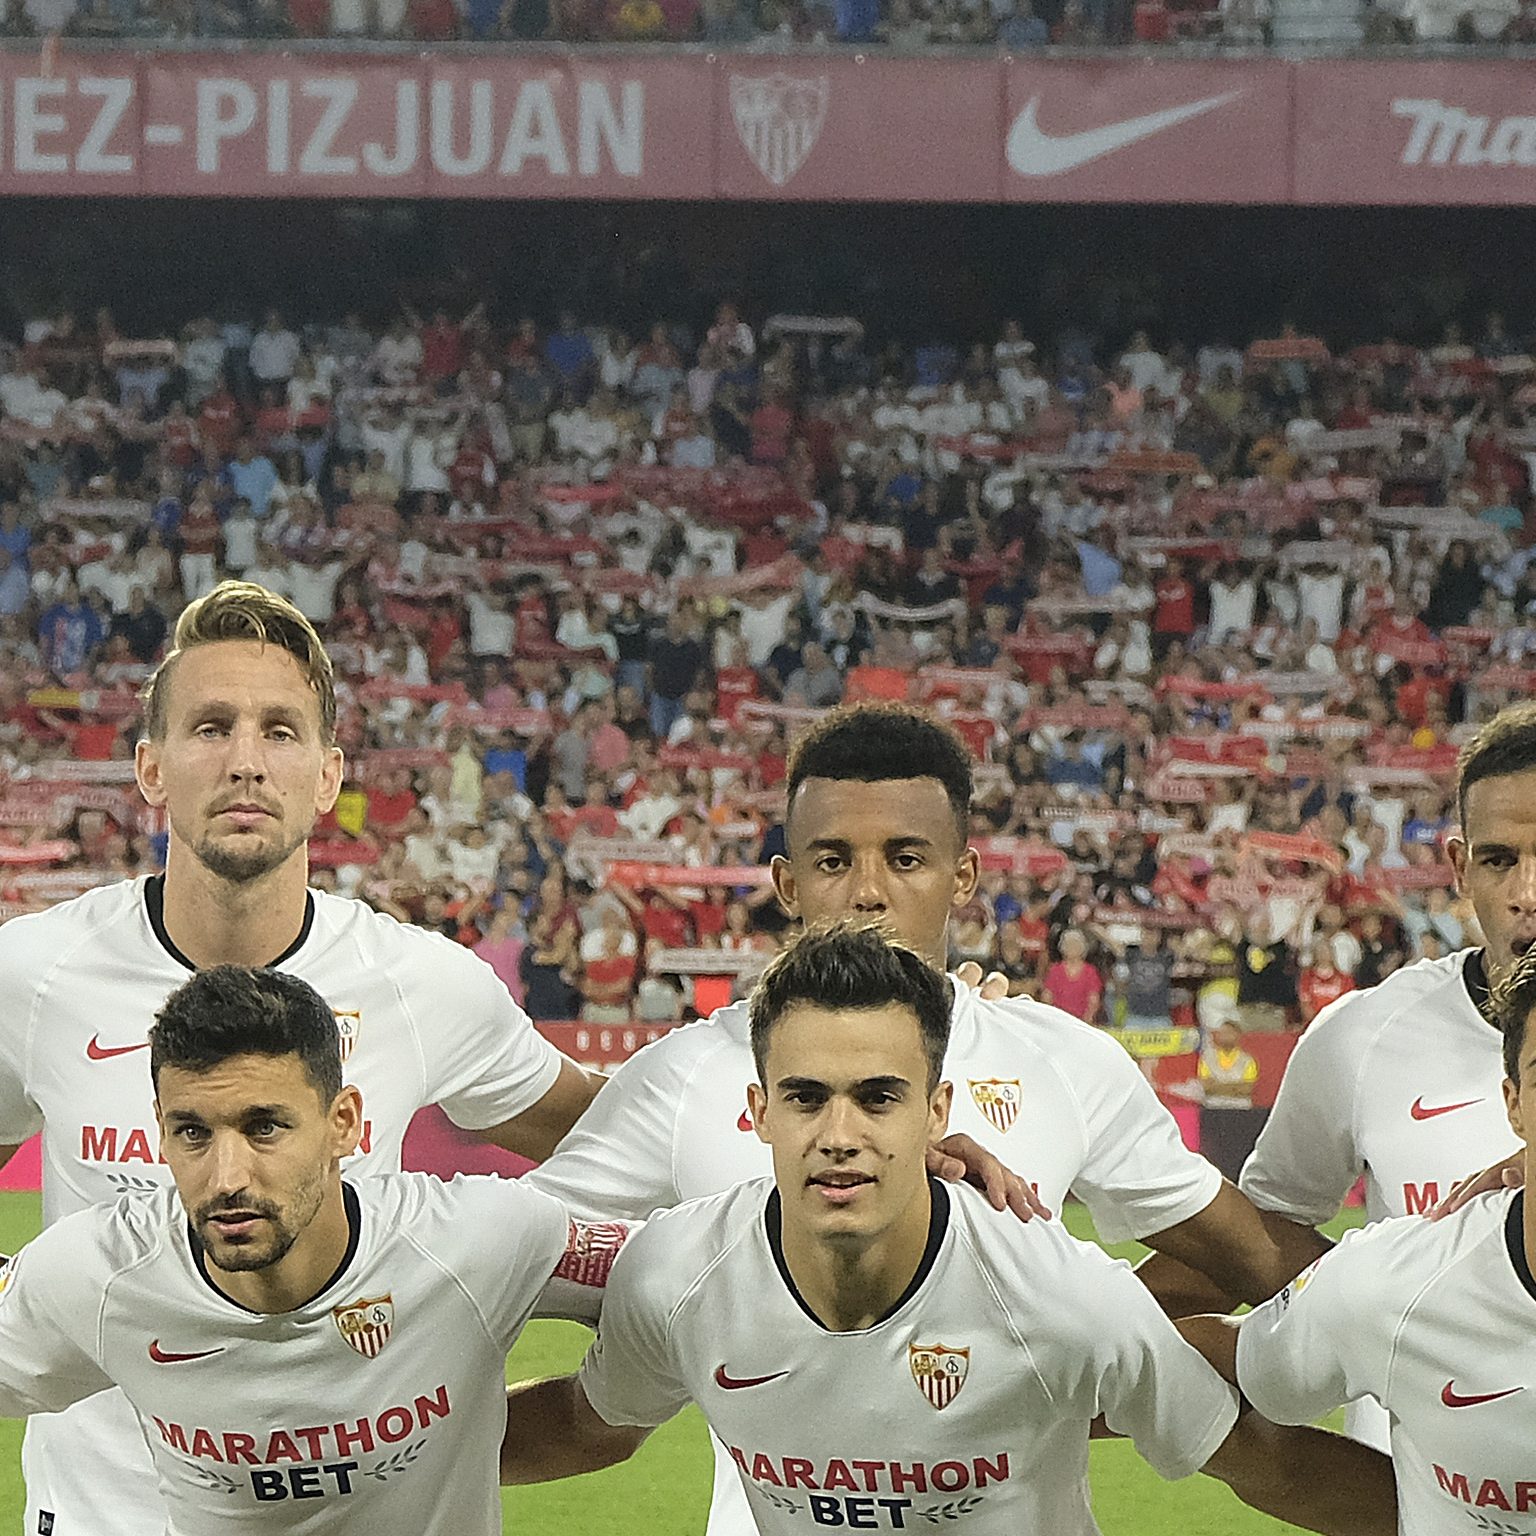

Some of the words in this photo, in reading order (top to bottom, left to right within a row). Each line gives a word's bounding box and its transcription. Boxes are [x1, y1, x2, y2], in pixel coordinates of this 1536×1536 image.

[152, 1384, 452, 1465] MARATHON
[250, 1460, 360, 1502] BET
[807, 1494, 913, 1529] BET
